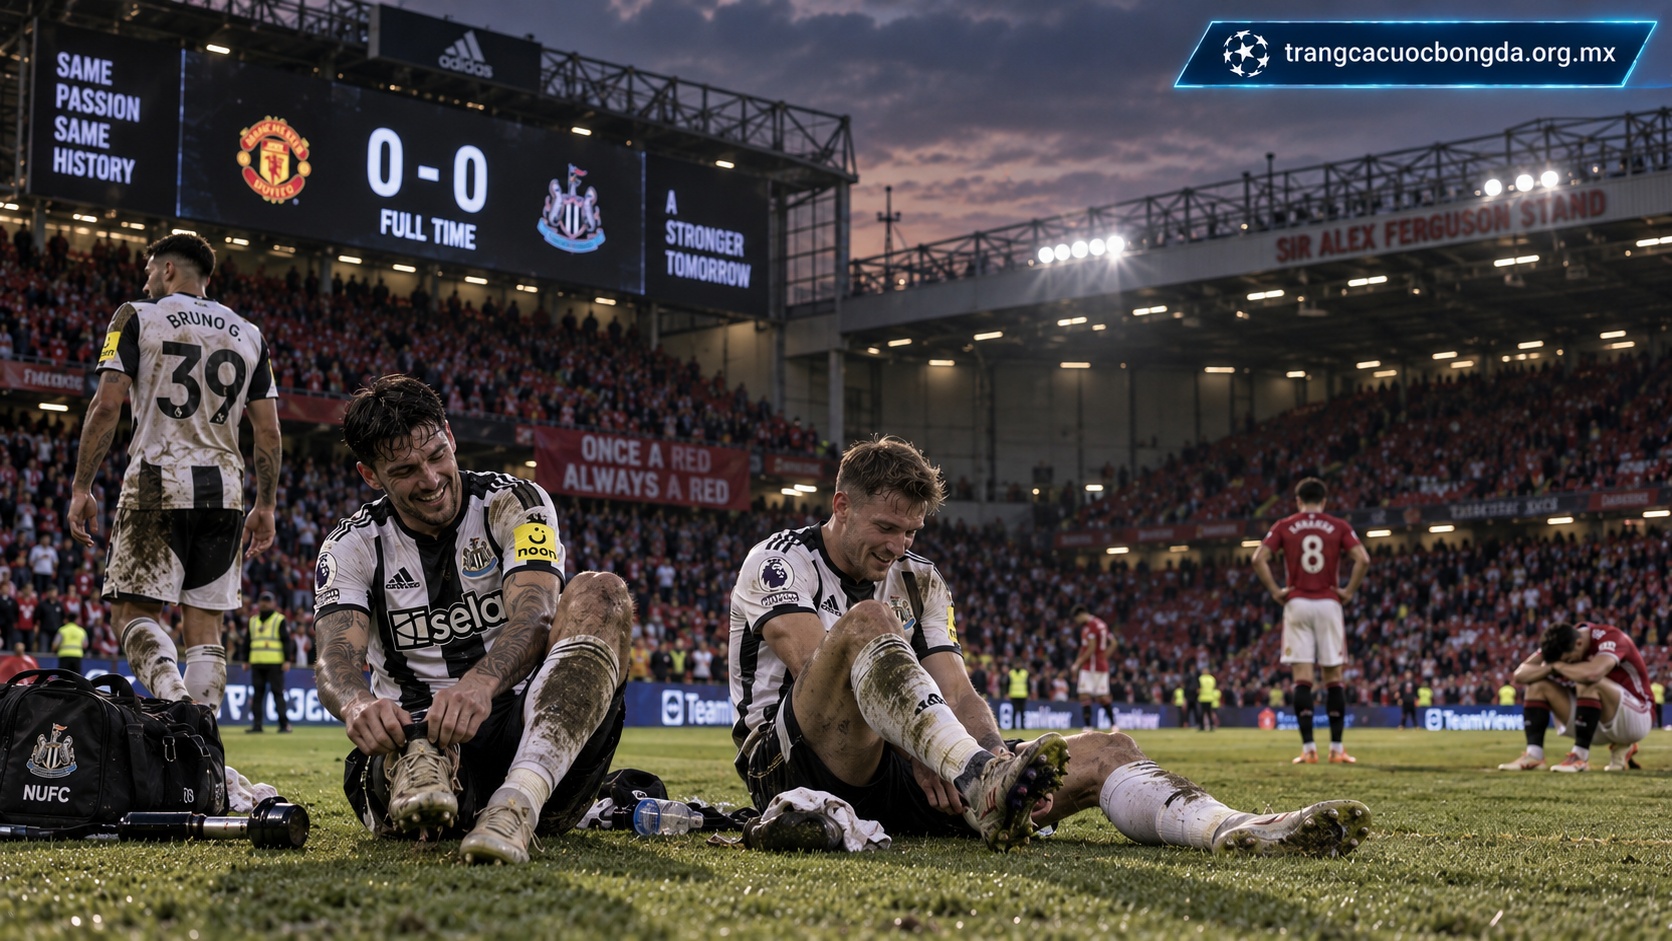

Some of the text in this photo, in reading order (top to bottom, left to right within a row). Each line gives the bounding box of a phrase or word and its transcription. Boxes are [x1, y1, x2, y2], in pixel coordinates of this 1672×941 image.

[57, 51, 113, 86] SAME
[439, 55, 493, 79] adidas
[56, 83, 140, 122] PASSION
[54, 117, 110, 149] SAME
[53, 147, 135, 184] HISTORY
[367, 127, 403, 198] 0
[453, 145, 488, 213] 0
[665, 190, 677, 215] A
[380, 209, 477, 250] FULL TIME
[665, 220, 744, 257] STRONGER
[1276, 189, 1607, 263] SIR ALEX FERGUSON STAND
[665, 250, 751, 288] TOMORROW
[166, 311, 225, 330] BRUNO
[156, 341, 246, 425] 39
[581, 435, 711, 472] ONCE A RED
[562, 463, 729, 504] ALWAYS A RED
[518, 545, 557, 560] noon
[1301, 534, 1325, 574] 8
[431, 593, 507, 641] sela
[23, 784, 71, 803] NUFC
